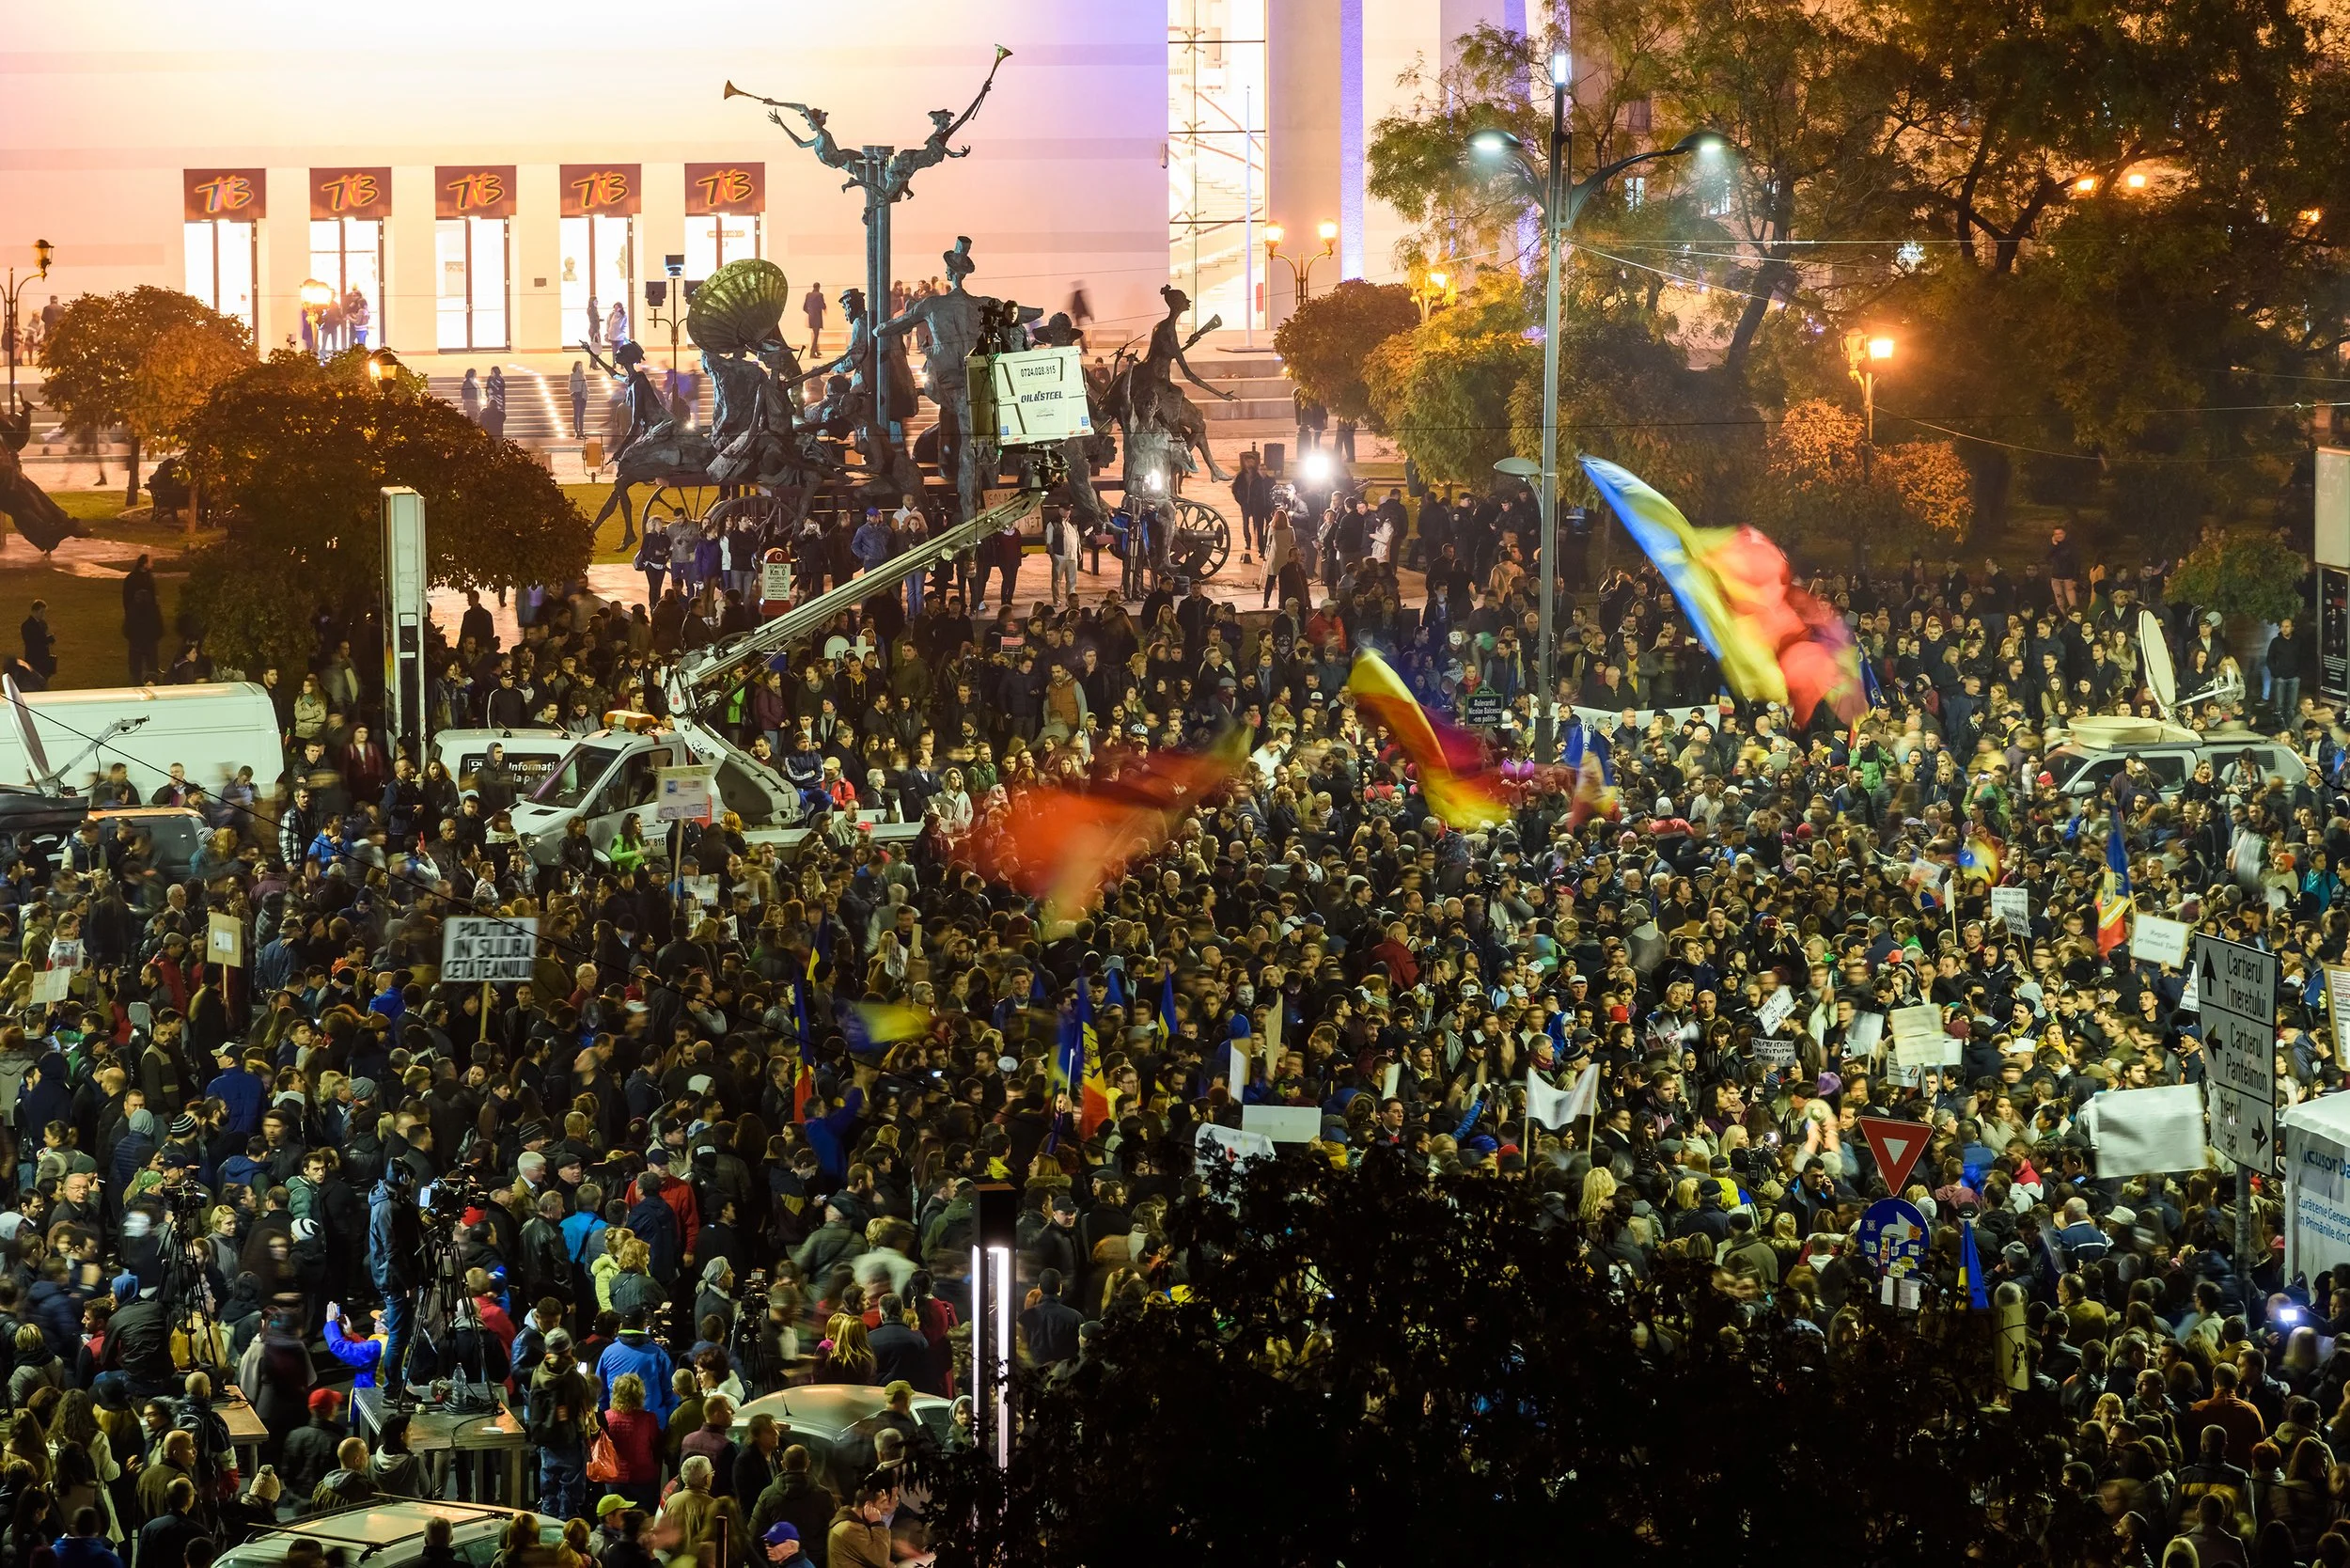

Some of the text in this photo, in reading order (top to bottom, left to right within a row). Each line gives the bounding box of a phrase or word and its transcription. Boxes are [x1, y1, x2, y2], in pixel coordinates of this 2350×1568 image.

[195, 175, 254, 212] TNB
[321, 173, 380, 212] TNB
[446, 172, 505, 209] TNB
[571, 171, 628, 208] TNB
[696, 169, 753, 206] TNB
[1021, 391, 1063, 402] OIL&STEEL
[513, 774, 522, 783] la
[2227, 949, 2264, 984] Cartierul
[2225, 980, 2266, 1018] Tineretului
[2231, 1022, 2264, 1058] Cartierul
[2226, 1053, 2267, 1092] Pantelimon
[2220, 1092, 2241, 1124] tierul
